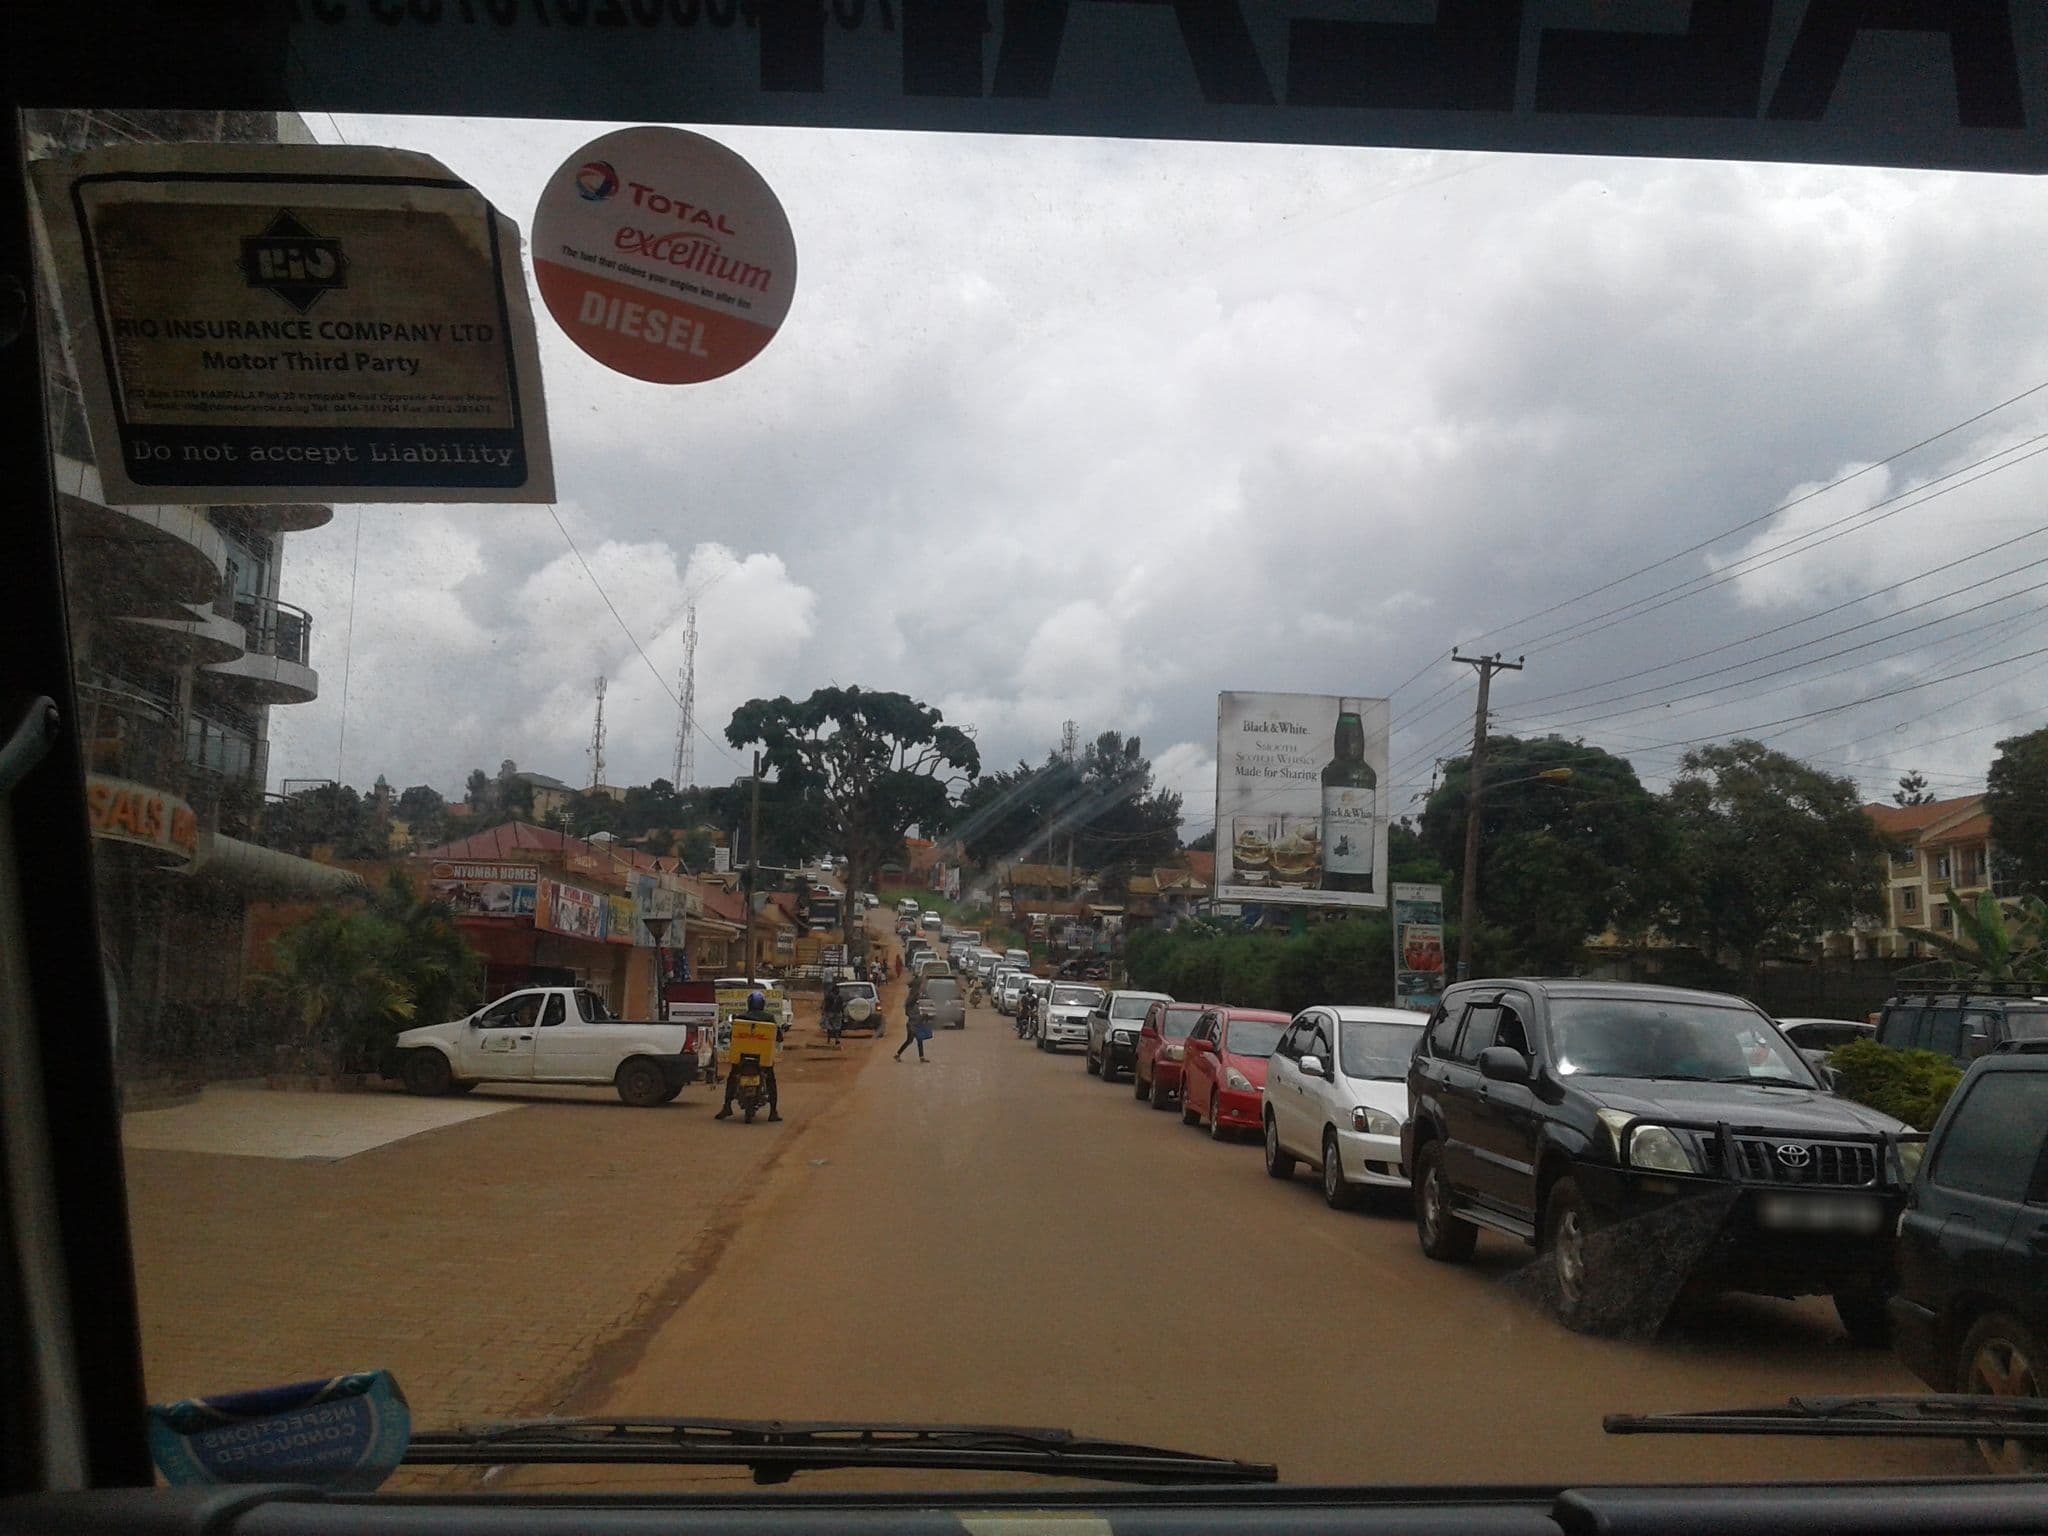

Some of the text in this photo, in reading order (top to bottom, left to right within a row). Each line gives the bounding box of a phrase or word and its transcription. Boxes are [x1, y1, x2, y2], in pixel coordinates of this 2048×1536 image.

[629, 182, 735, 235] TOTAL
[615, 226, 772, 292] excellium
[166, 319, 312, 341] INSURANCE
[319, 321, 442, 343] COMPANY
[451, 323, 493, 343] LTD
[579, 290, 708, 357] DIESEL
[203, 351, 420, 377] Motor Third Party
[134, 440, 514, 467] Do not accept Liability
[1235, 766, 1318, 782] Made for Sharing
[453, 865, 537, 881] NYUMBA HOMES
